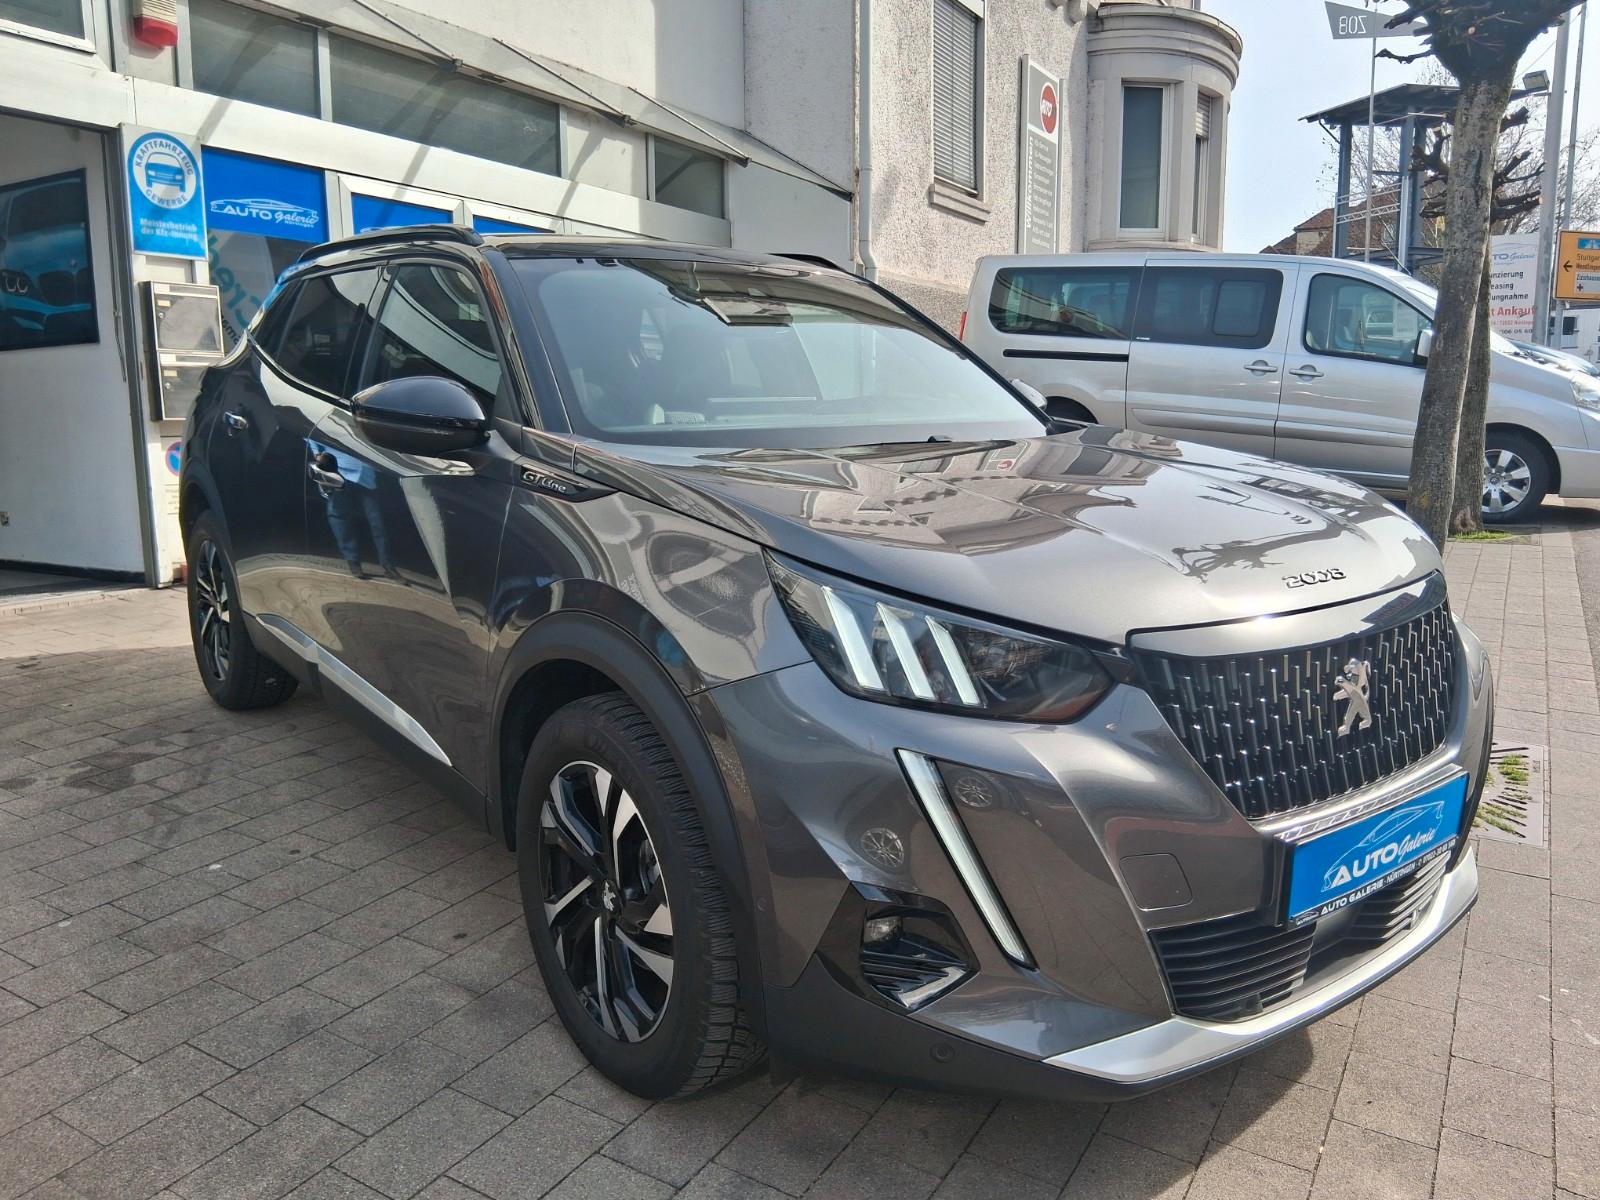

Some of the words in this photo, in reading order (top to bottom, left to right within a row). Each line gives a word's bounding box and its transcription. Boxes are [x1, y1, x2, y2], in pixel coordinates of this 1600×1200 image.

[135, 140, 194, 176] KRAFTFAHRZEUG
[145, 188, 189, 207] GEWERBE
[223, 204, 272, 220] AUTO
[140, 218, 198, 232] Meisterbetrieb
[1490, 283, 1514, 291] easing
[1491, 293, 1529, 303] ungnahme
[522, 471, 545, 485] GT
[1281, 568, 1347, 589] 2008
[1331, 842, 1399, 889] AUTO
[1320, 897, 1348, 916] AUTO
[1348, 878, 1384, 903] GALERIE
[1386, 861, 1416, 884] NÜRTINGEN
